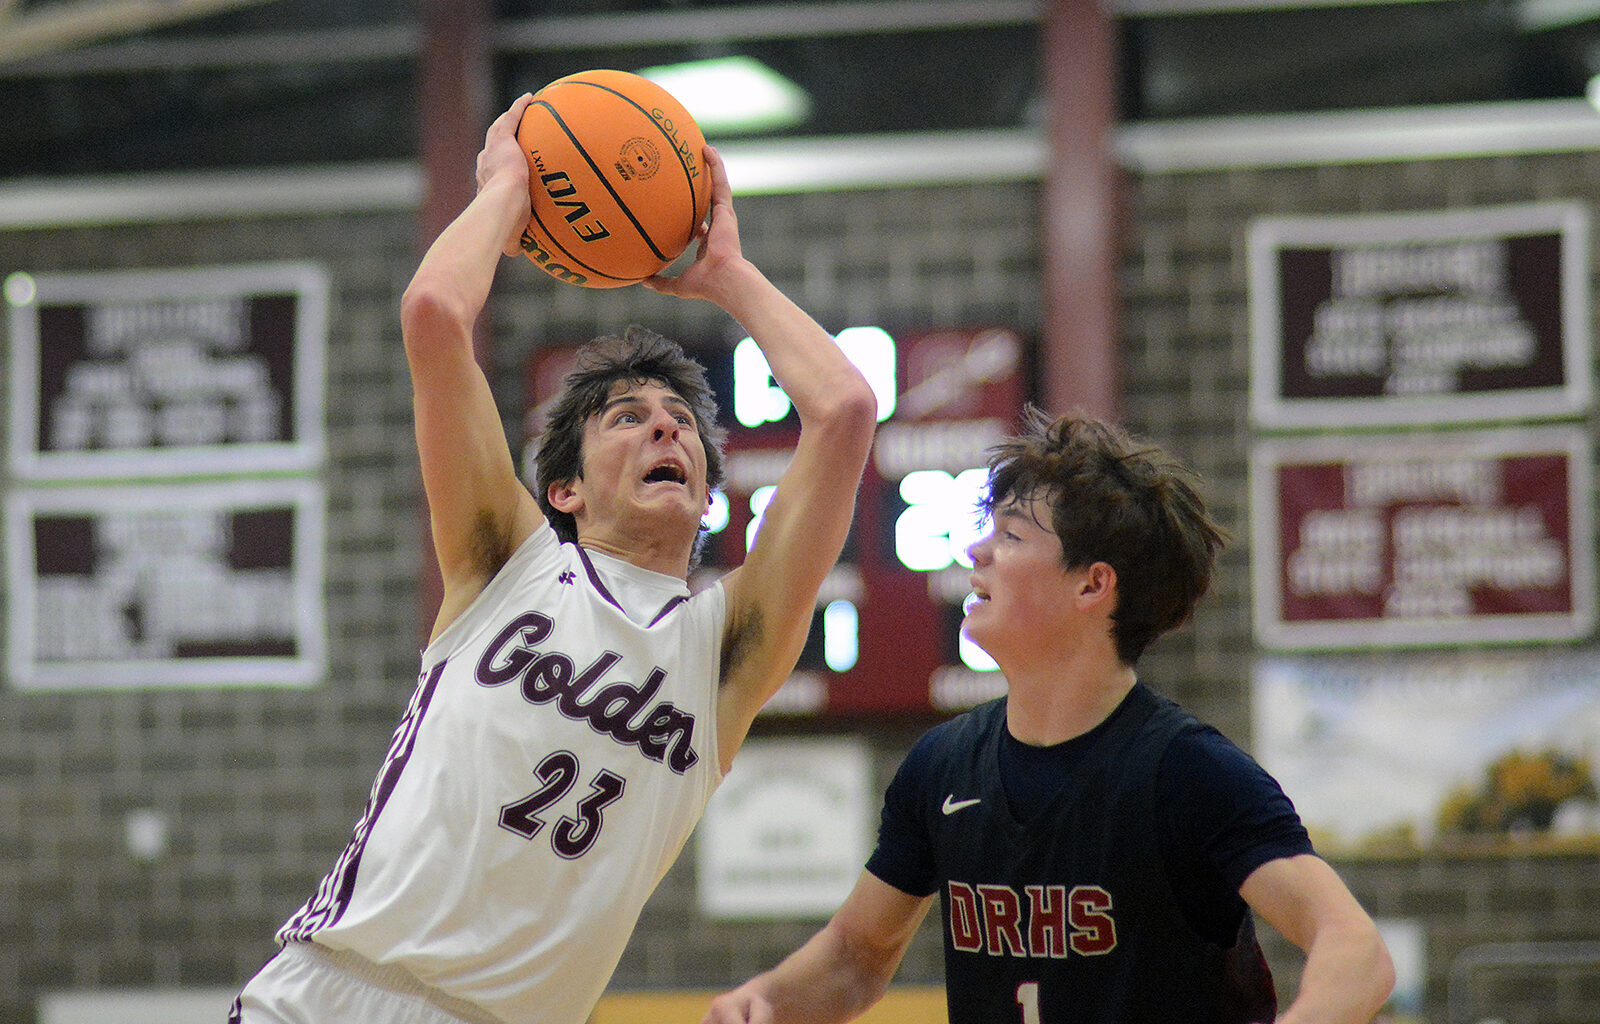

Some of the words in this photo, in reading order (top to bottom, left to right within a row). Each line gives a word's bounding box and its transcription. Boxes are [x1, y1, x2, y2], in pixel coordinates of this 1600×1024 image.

[530, 149, 546, 173] NXT
[651, 107, 700, 179] GOLDEN
[541, 170, 611, 243] EVO
[474, 610, 700, 776] Golden
[497, 749, 627, 861] 23
[948, 879, 1118, 959] DRHS
